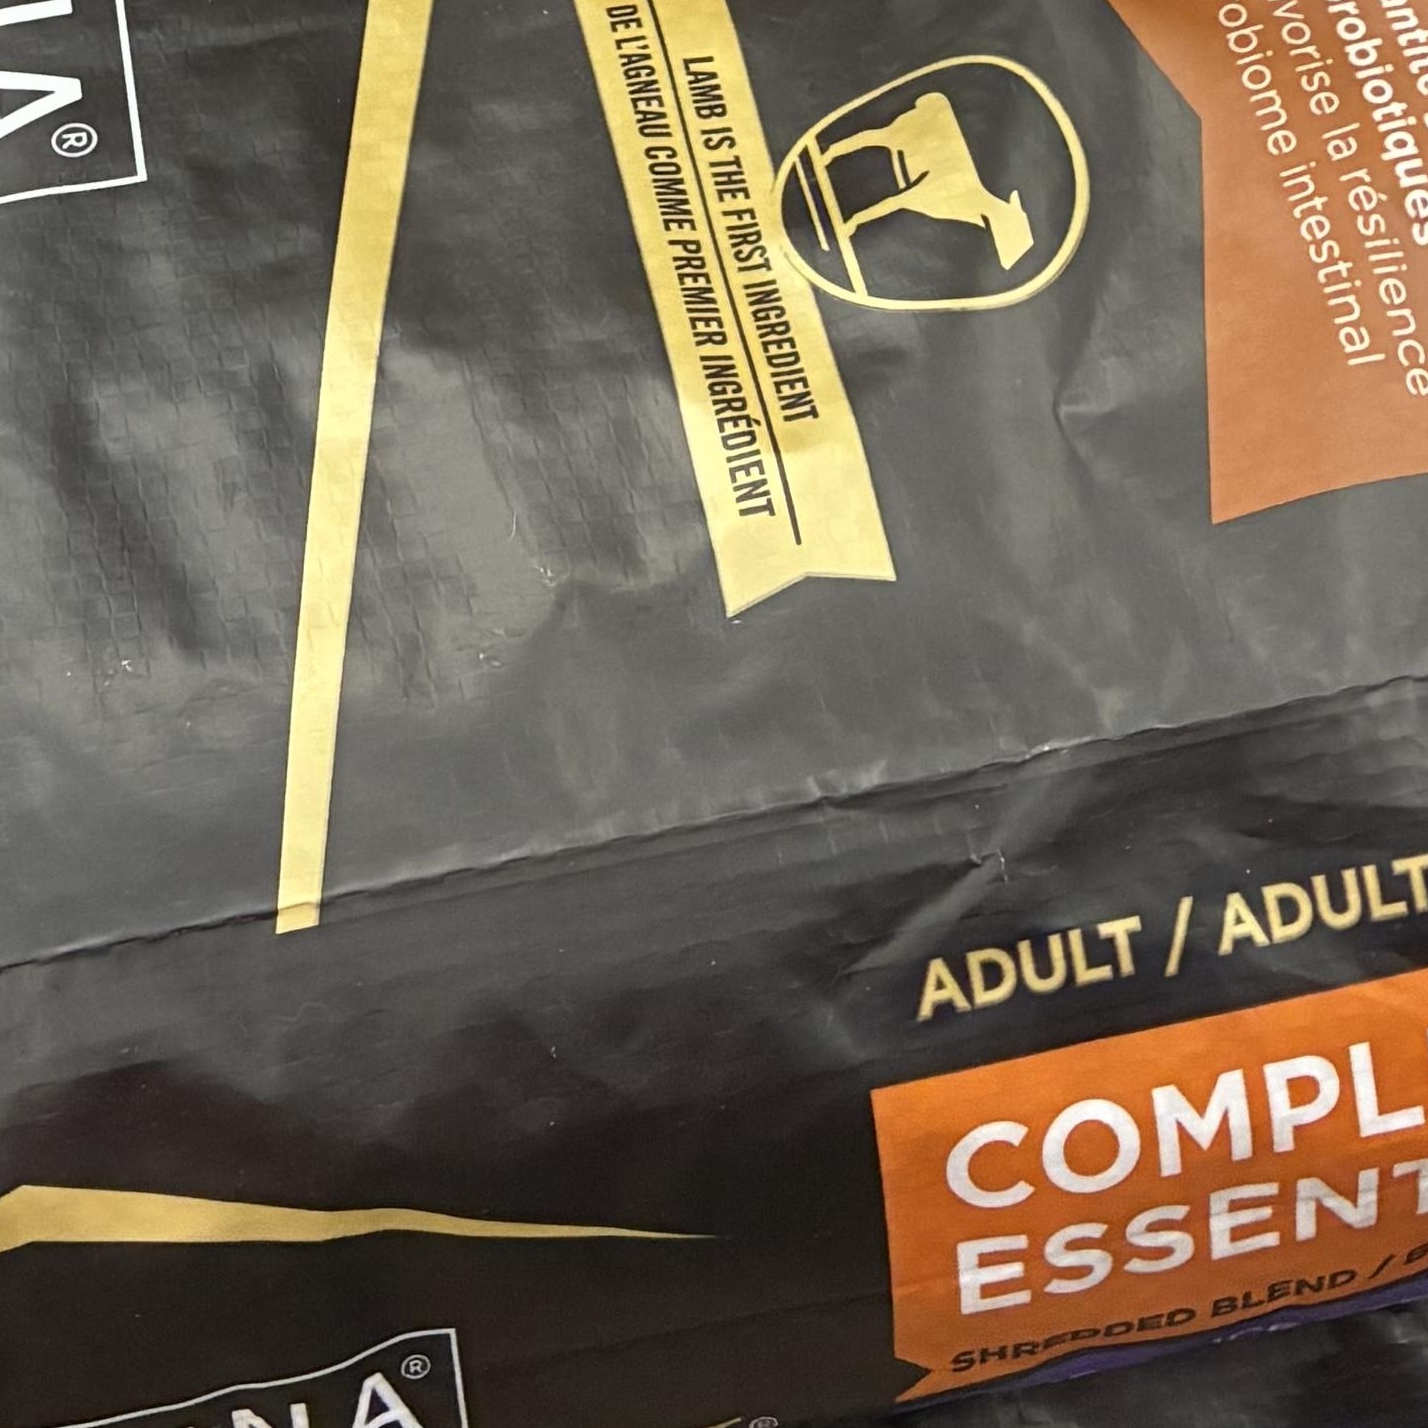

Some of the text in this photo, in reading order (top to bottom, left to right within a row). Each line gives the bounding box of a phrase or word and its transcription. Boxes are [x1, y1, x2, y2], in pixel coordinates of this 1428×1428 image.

[1322, 121, 1363, 163] la
[605, 3, 777, 520] DE L'AGNEAU COMME PREMIER INGRÉDIENT
[682, 55, 820, 425] LAMB IS THE FIRST INGREDIENT
[1279, 163, 1387, 367] intestinal
[914, 914, 1144, 1023] ADULT
[949, 1306, 1198, 1374] SHREDDED
[1210, 1268, 1358, 1319] BLEND
